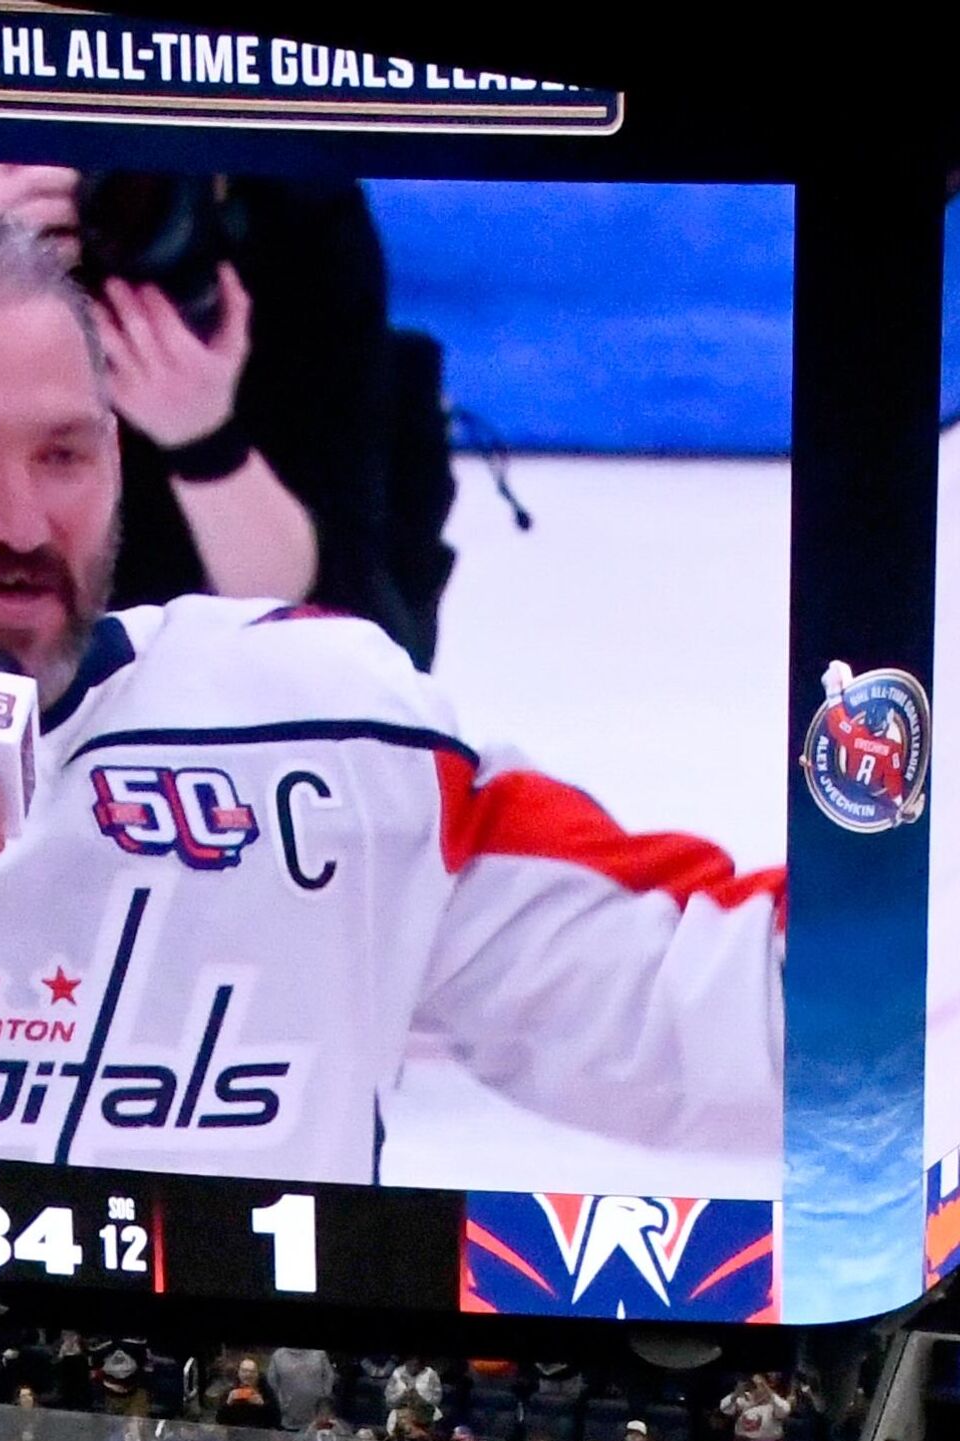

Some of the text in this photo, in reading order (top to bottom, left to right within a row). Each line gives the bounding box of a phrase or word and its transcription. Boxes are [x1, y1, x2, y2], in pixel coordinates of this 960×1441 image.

[67, 30, 260, 84] ALL-TIME
[90, 765, 260, 870] 50
[276, 770, 337, 890] C
[108, 1196, 136, 1222] SOG
[251, 1193, 318, 1294] 1
[99, 1224, 149, 1273] 12
